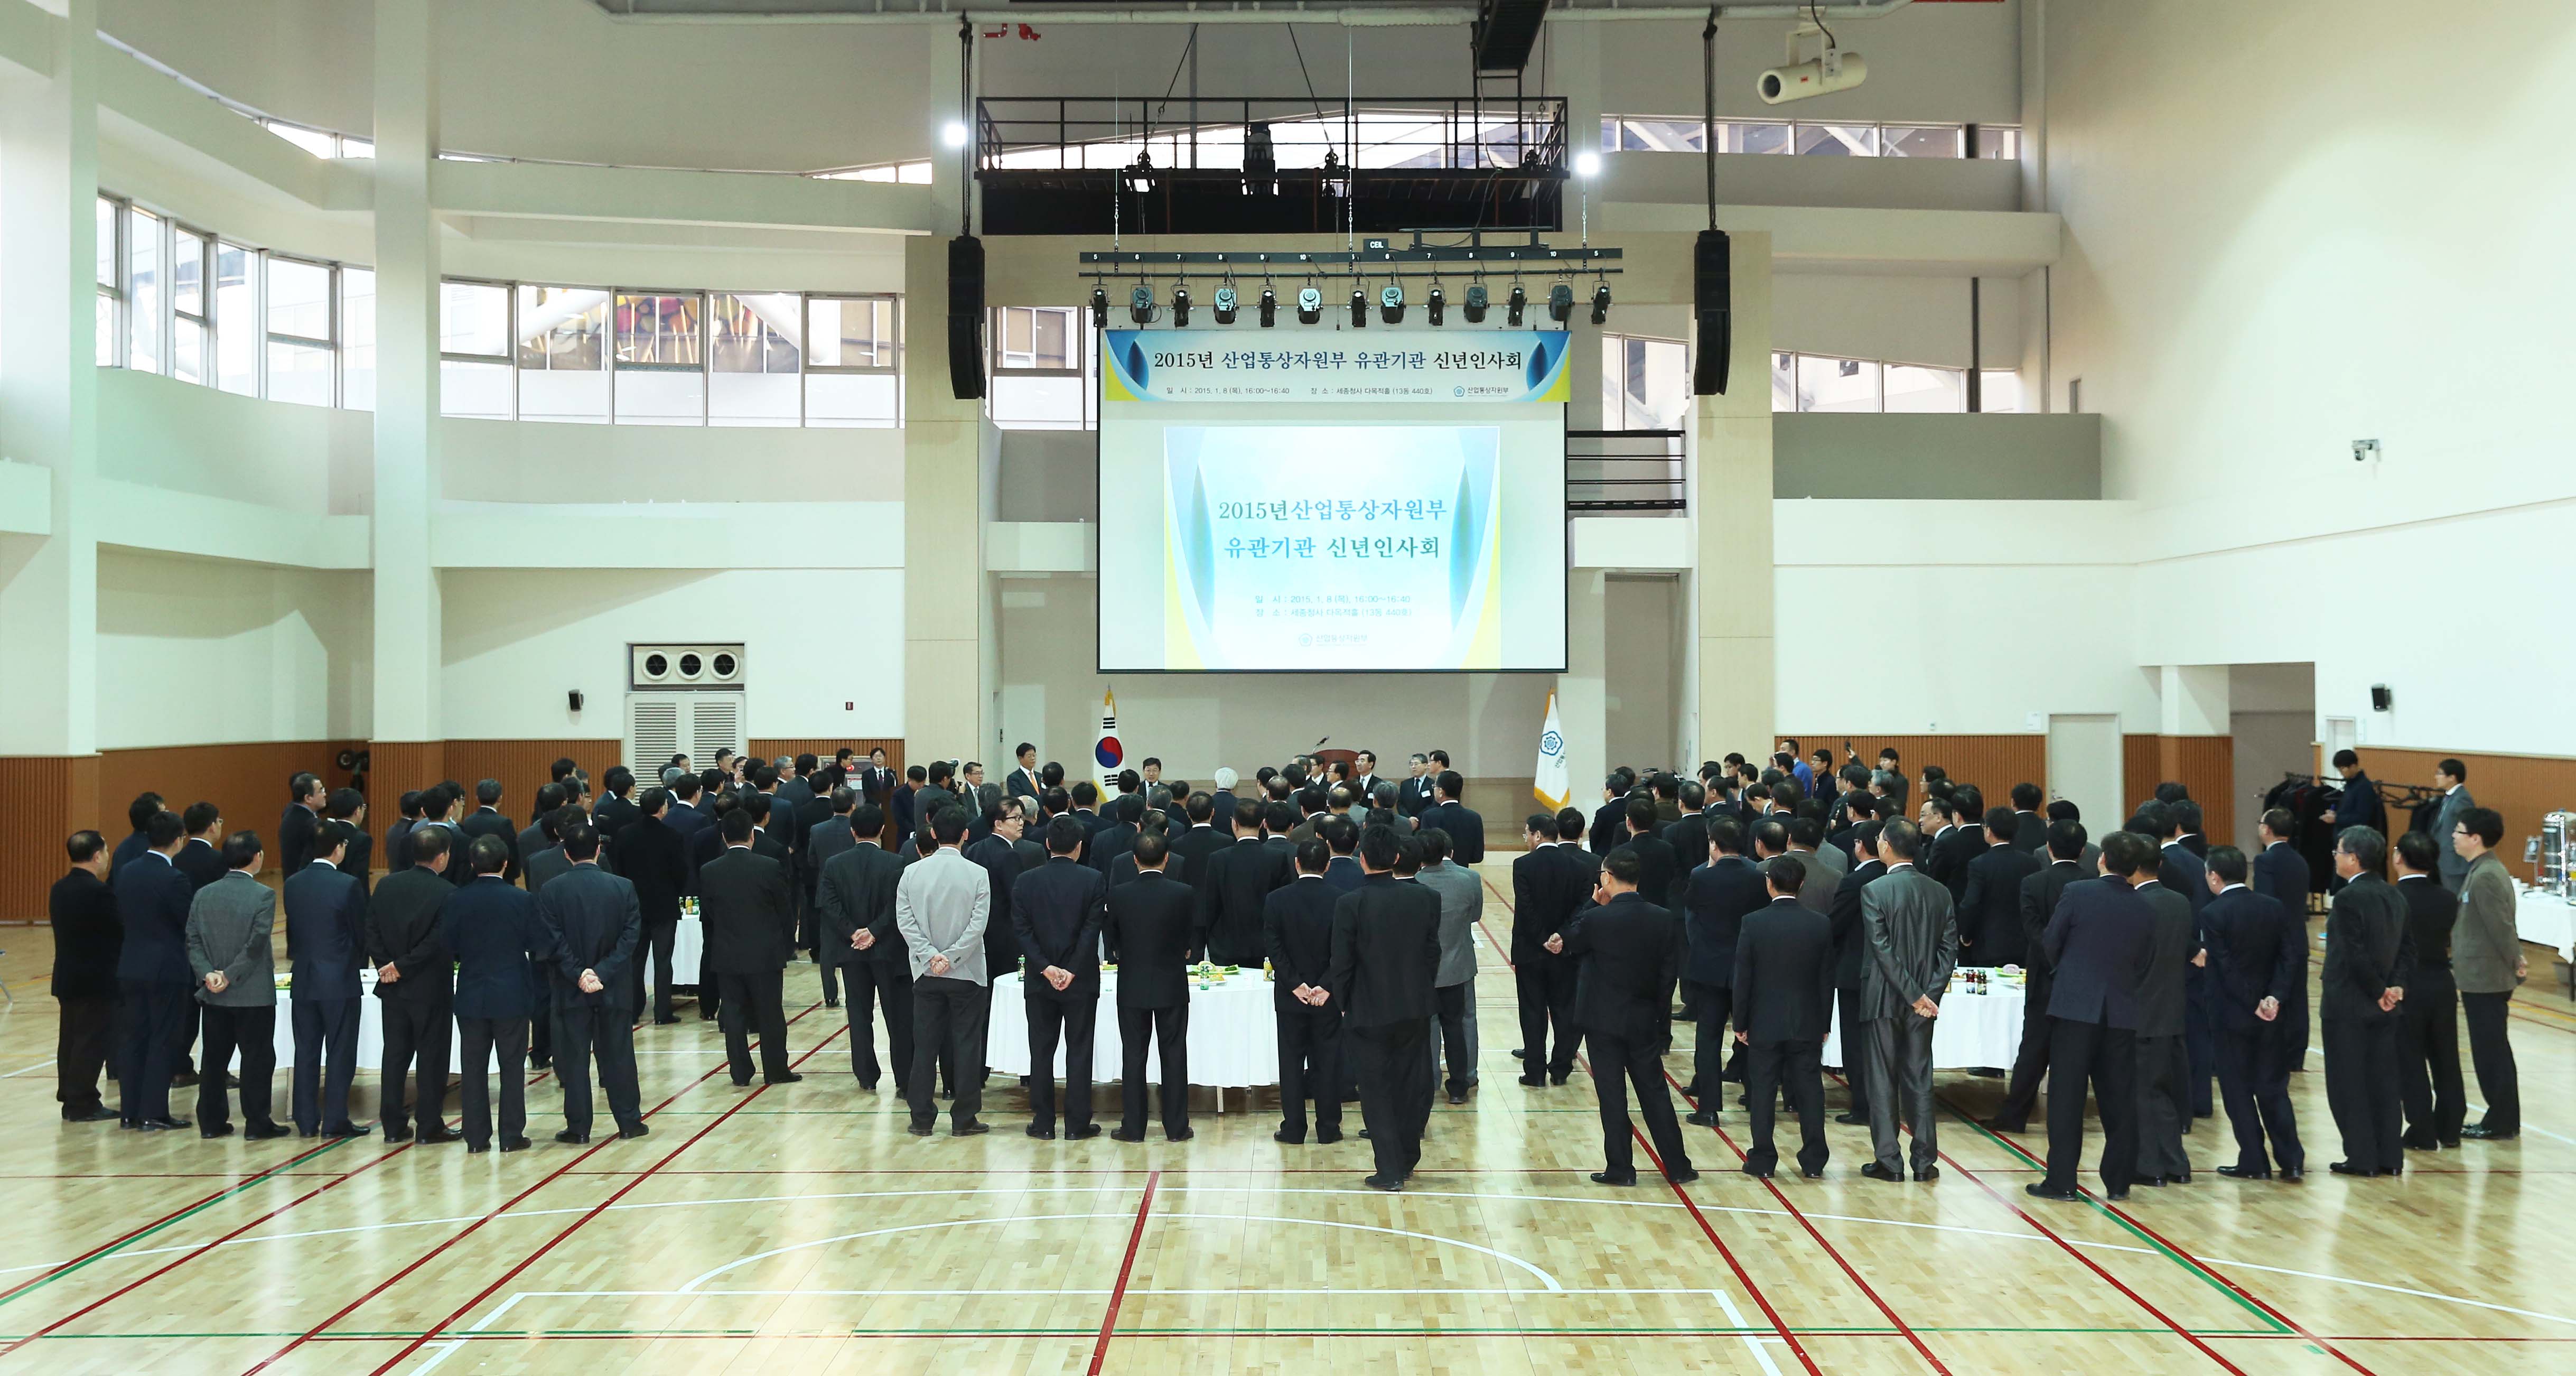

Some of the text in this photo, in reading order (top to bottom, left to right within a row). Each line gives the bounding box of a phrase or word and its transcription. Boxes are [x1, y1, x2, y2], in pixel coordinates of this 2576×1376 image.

[1154, 351, 1521, 370] 2015년 산업통상자원부 유관기관 신년인사회
[1224, 536, 1439, 559] 유관기관 신년인사회
[1255, 595, 1263, 604] 일
[1272, 595, 1281, 604] 시
[1255, 608, 1264, 617] 장
[1272, 608, 1281, 617] 소
[1290, 608, 1324, 617] 세종청사
[1326, 608, 1359, 617] 다목적홀
[1361, 608, 1383, 617] (13동
